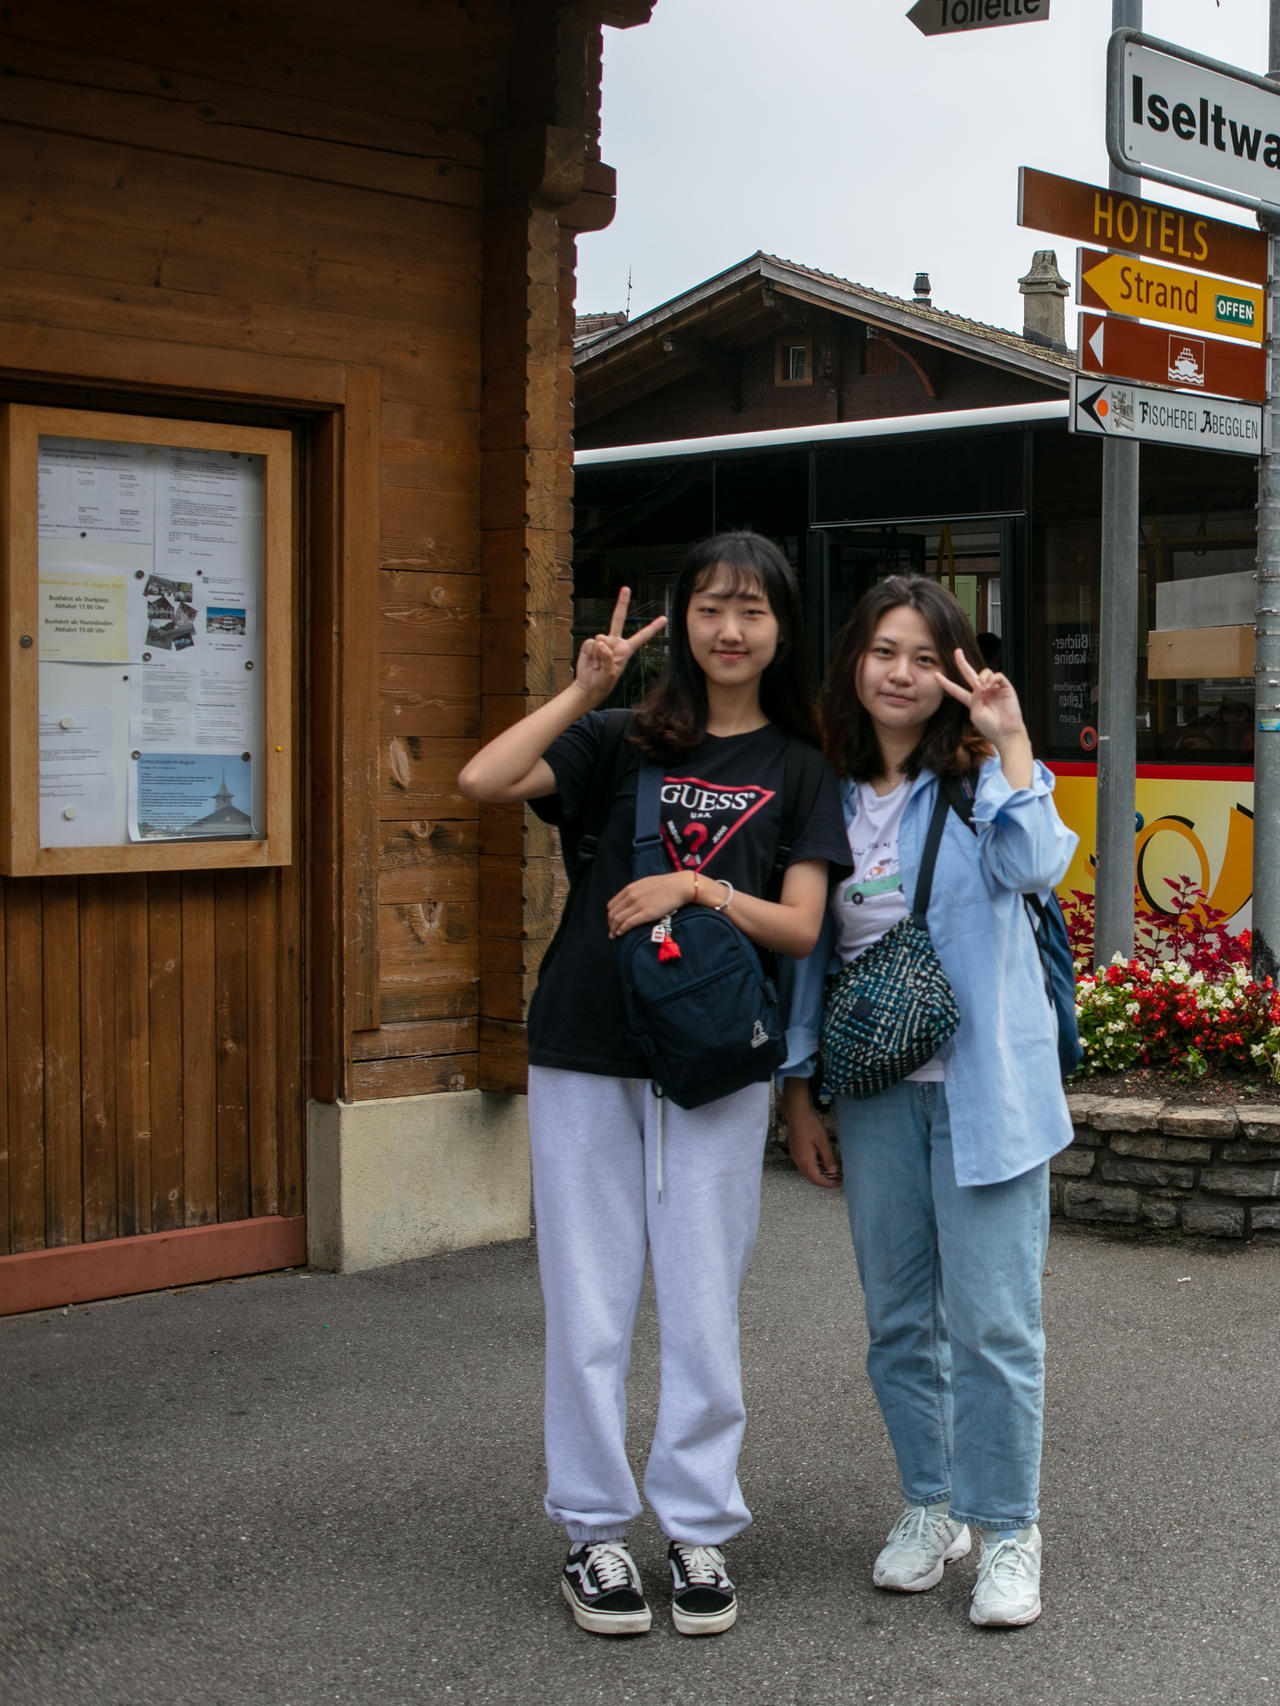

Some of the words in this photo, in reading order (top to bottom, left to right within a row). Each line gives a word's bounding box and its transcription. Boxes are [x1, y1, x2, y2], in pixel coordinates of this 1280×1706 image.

[1094, 192, 1209, 262] HOTELS
[1119, 265, 1198, 314] Strand
[1217, 300, 1253, 320] OFFEN
